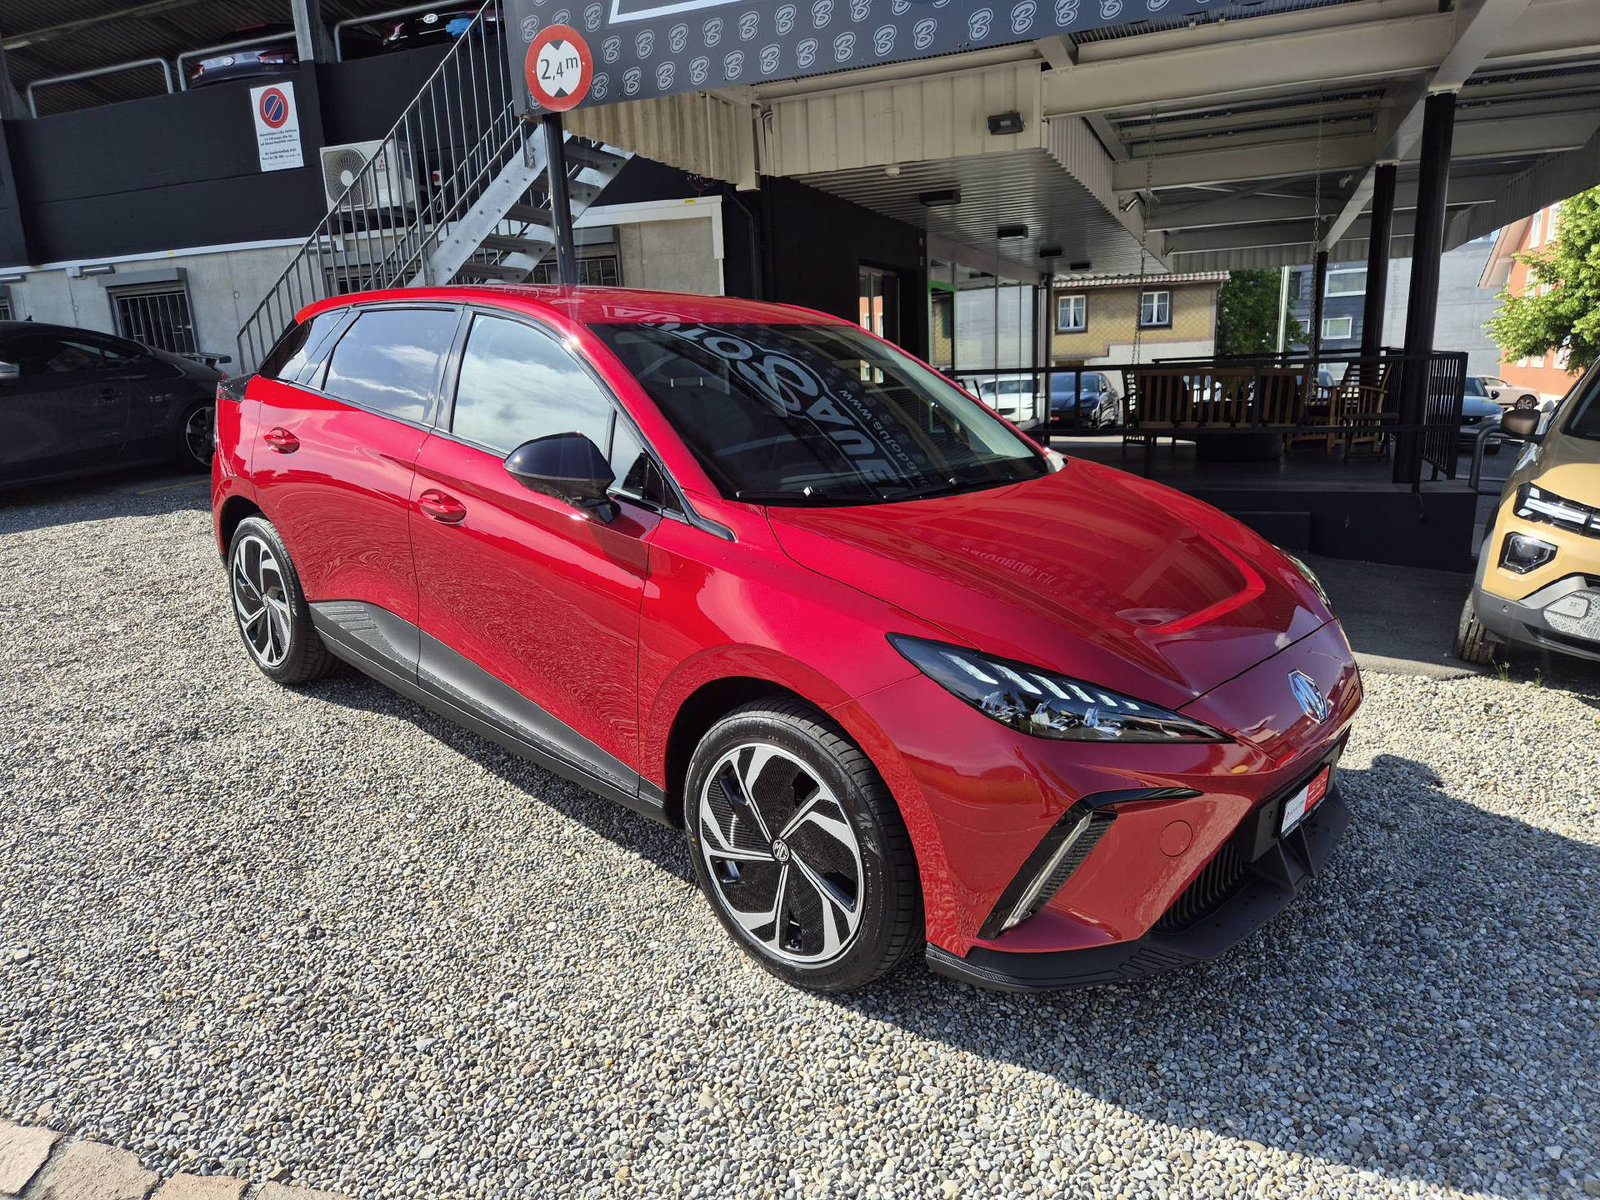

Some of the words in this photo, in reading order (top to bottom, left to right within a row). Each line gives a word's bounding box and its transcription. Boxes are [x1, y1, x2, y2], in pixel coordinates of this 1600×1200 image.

[592, 72, 609, 100] B
[623, 67, 641, 95] B
[656, 61, 675, 90] B
[689, 56, 709, 85] B
[724, 50, 744, 80] B
[760, 44, 780, 74] B
[796, 38, 818, 68] B
[833, 32, 856, 62] B
[874, 25, 896, 56] B
[913, 18, 937, 50] B
[968, 8, 993, 40] B
[1010, 0, 1037, 34] B
[1054, 0, 1079, 27] B
[602, 36, 621, 63] B
[635, 30, 655, 59] B
[669, 23, 688, 53] B
[703, 18, 723, 47] B
[739, 11, 759, 41] B
[775, 4, 796, 35] B
[812, 0, 834, 28] B
[773, 841, 788, 861] MG
